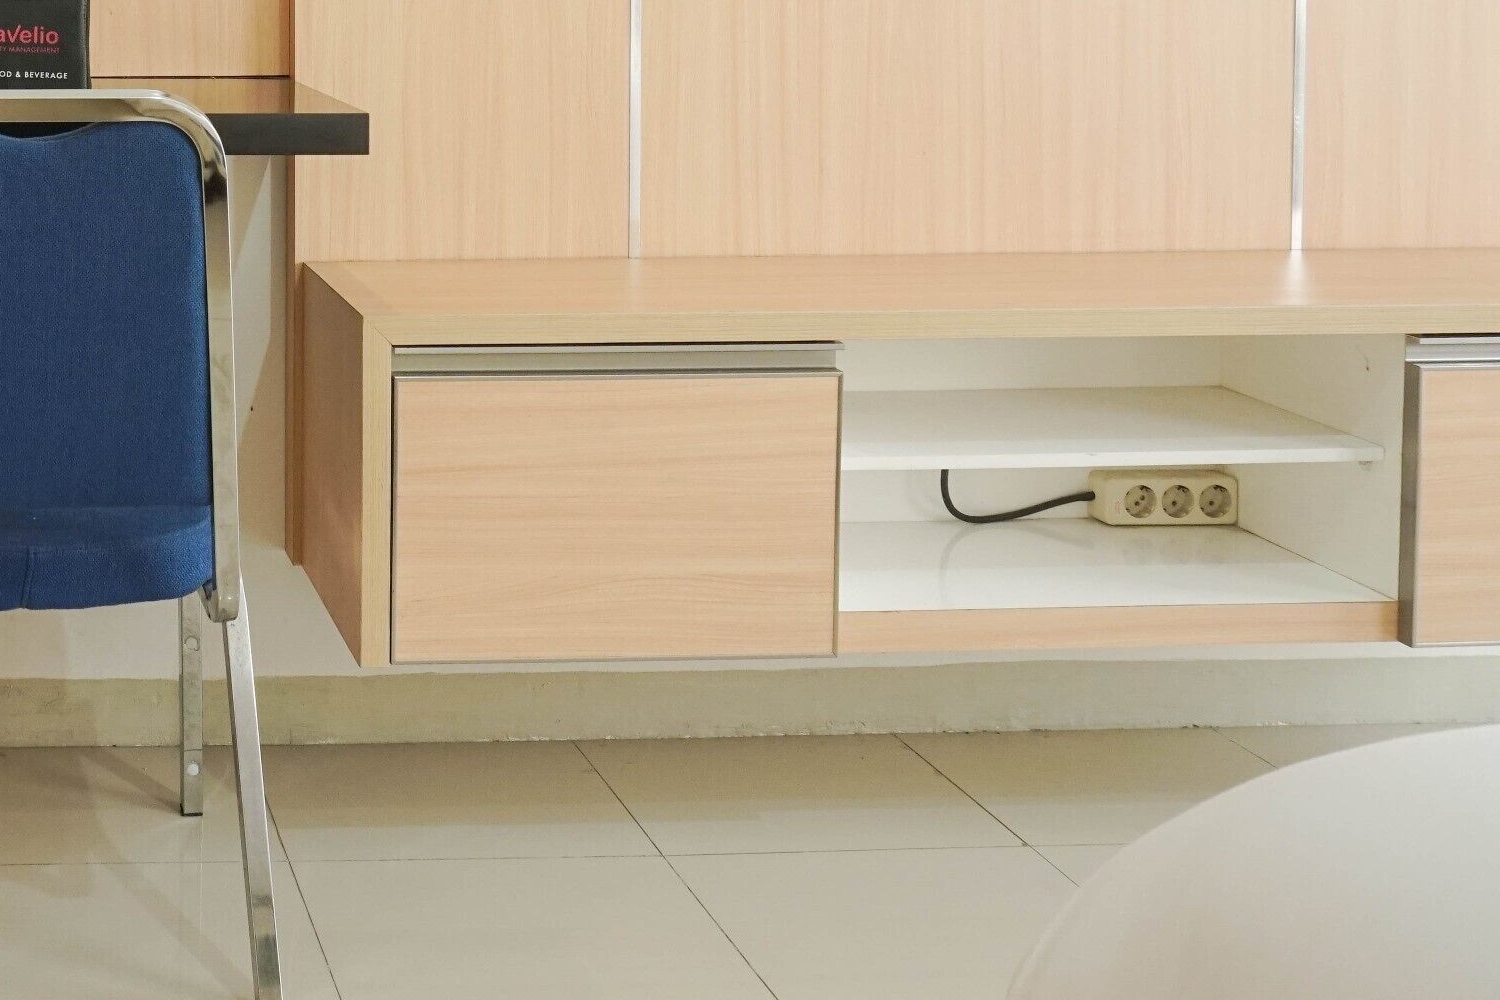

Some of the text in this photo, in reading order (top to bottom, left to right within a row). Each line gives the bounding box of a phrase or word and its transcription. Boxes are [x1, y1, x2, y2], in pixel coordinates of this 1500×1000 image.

[9, 46, 60, 54] MANAGEMENT
[15, 70, 21, 78] &
[24, 70, 68, 80] BEVERAGE
